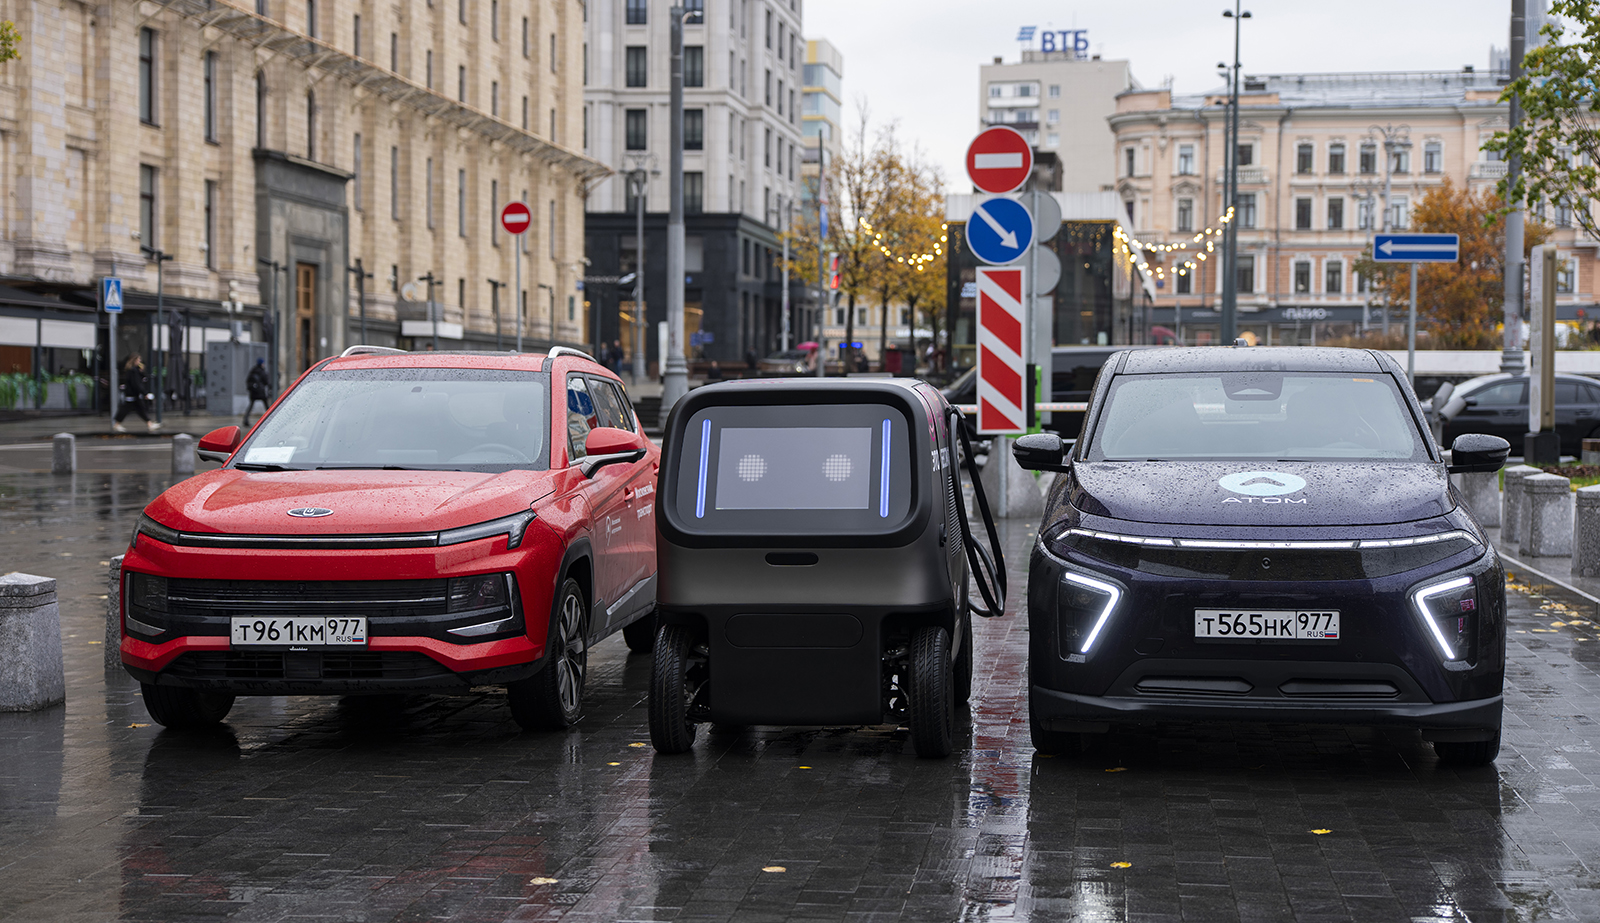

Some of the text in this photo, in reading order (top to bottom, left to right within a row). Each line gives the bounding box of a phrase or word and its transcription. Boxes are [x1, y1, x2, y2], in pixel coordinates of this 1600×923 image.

[1042, 30, 1089, 53] ВТБ
[239, 619, 361, 641] Т961КМ 977
[1202, 613, 1333, 637] Т565НК 977
